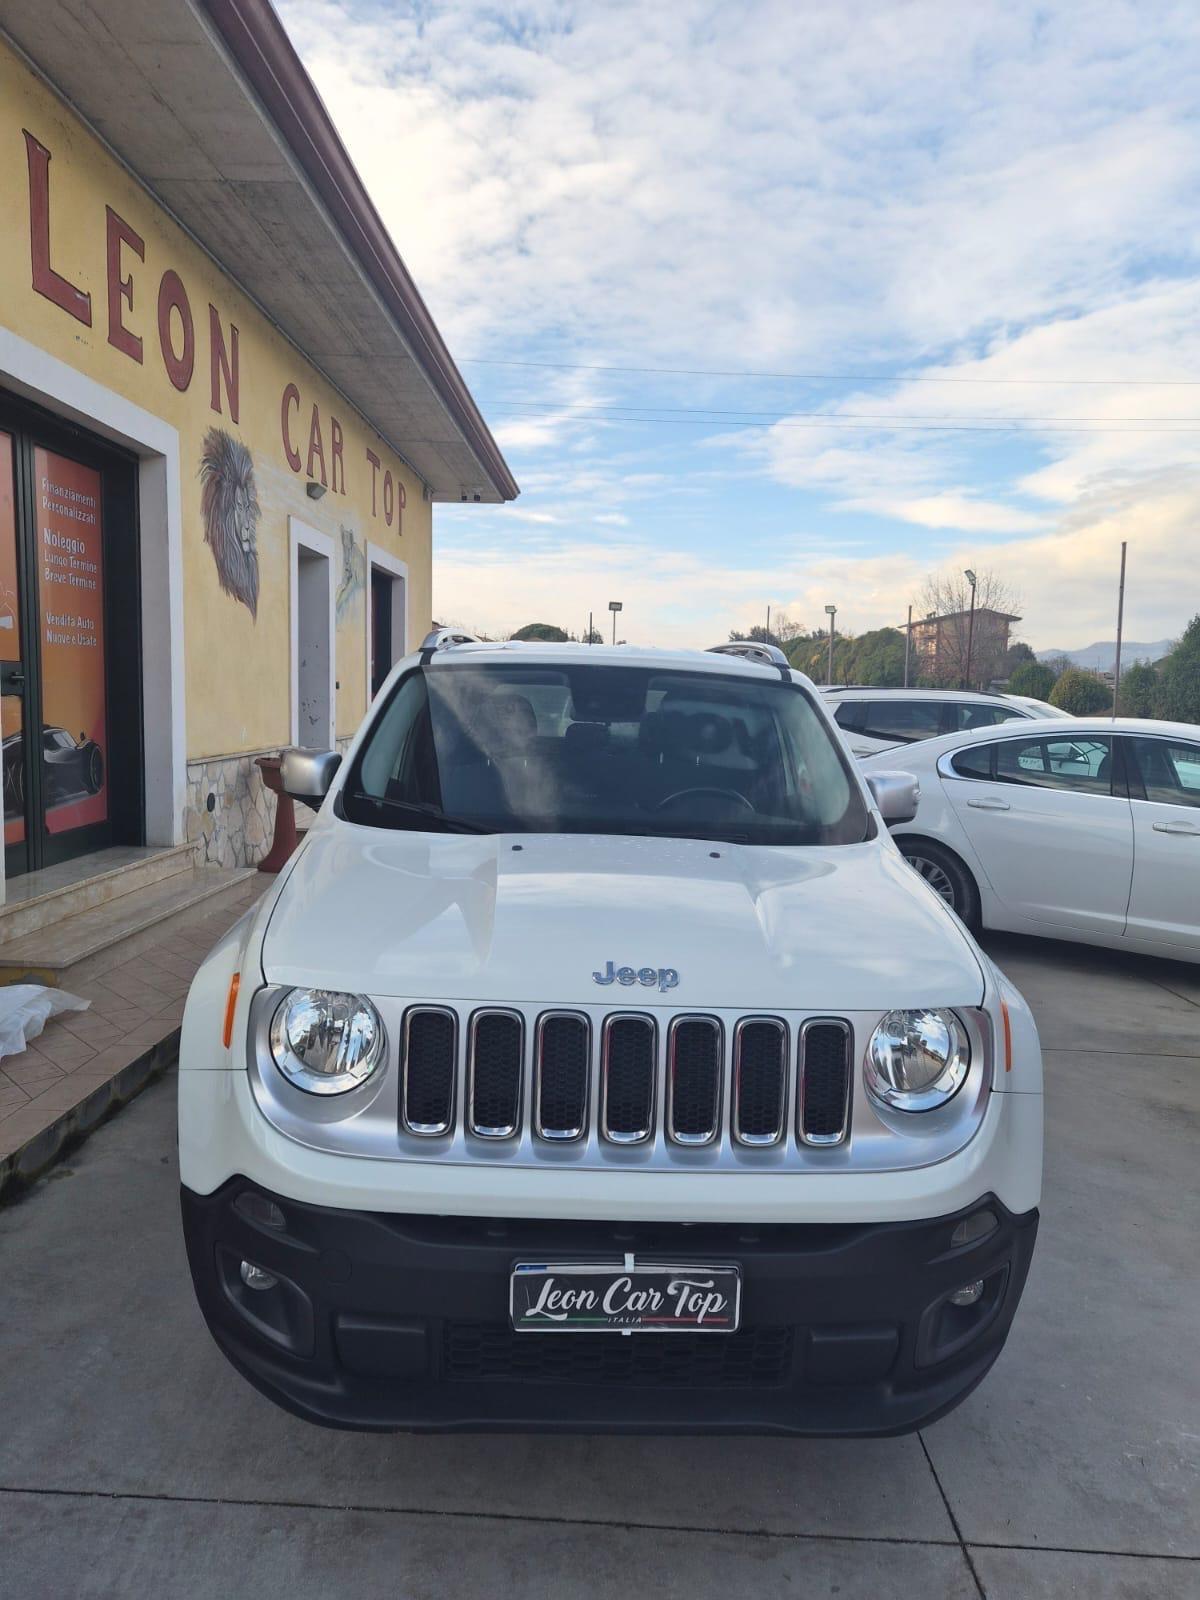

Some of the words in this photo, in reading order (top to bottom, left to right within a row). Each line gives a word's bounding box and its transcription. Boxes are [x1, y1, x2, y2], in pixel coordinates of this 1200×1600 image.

[22, 128, 240, 425] LEON
[281, 383, 346, 496] CAR
[366, 447, 407, 537] TOP
[42, 477, 96, 508] Finanziamenti
[43, 527, 86, 554] Noleggio
[44, 567, 67, 584] Breve
[46, 611, 76, 627] Vendita
[77, 616, 95, 630] Auto
[592, 960, 680, 993] Jeep
[525, 1278, 599, 1321] Leon
[602, 1277, 665, 1315] Car
[666, 1280, 728, 1324] Top
